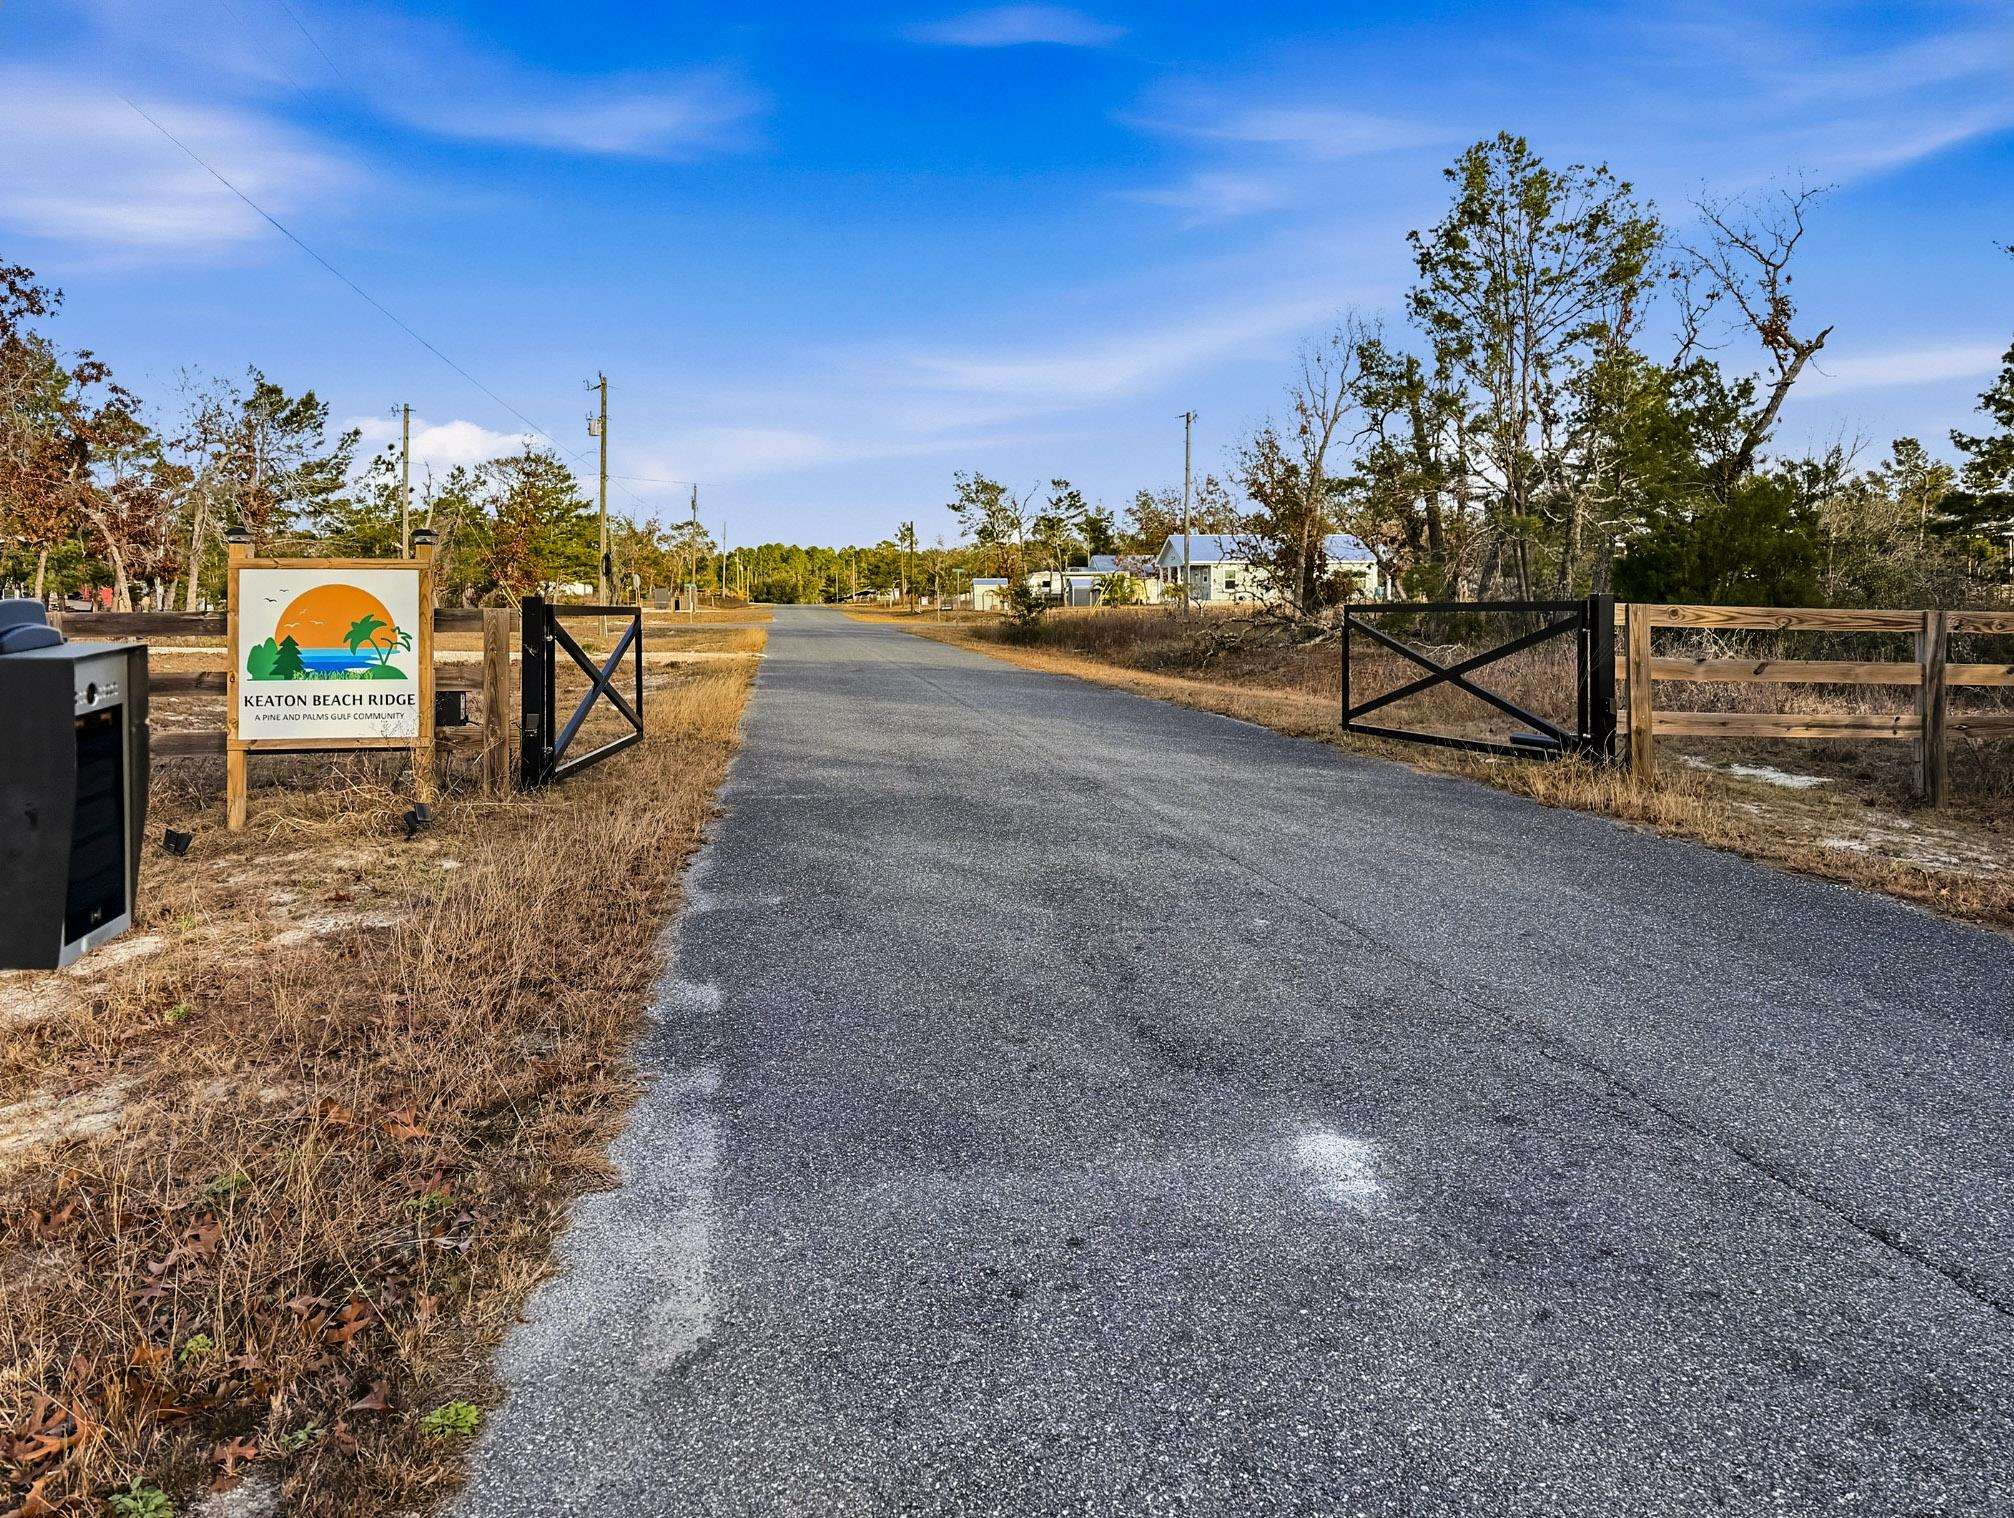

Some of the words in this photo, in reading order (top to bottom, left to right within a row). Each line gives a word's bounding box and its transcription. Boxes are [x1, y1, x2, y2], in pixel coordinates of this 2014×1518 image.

[244, 695, 307, 707] KEATON
[313, 694, 363, 707] BEACH
[368, 693, 416, 706] RIDGE
[282, 713, 301, 721] AND
[302, 713, 329, 721] PALMS
[330, 712, 351, 721] GULF
[353, 712, 405, 720] COMMUNITY
